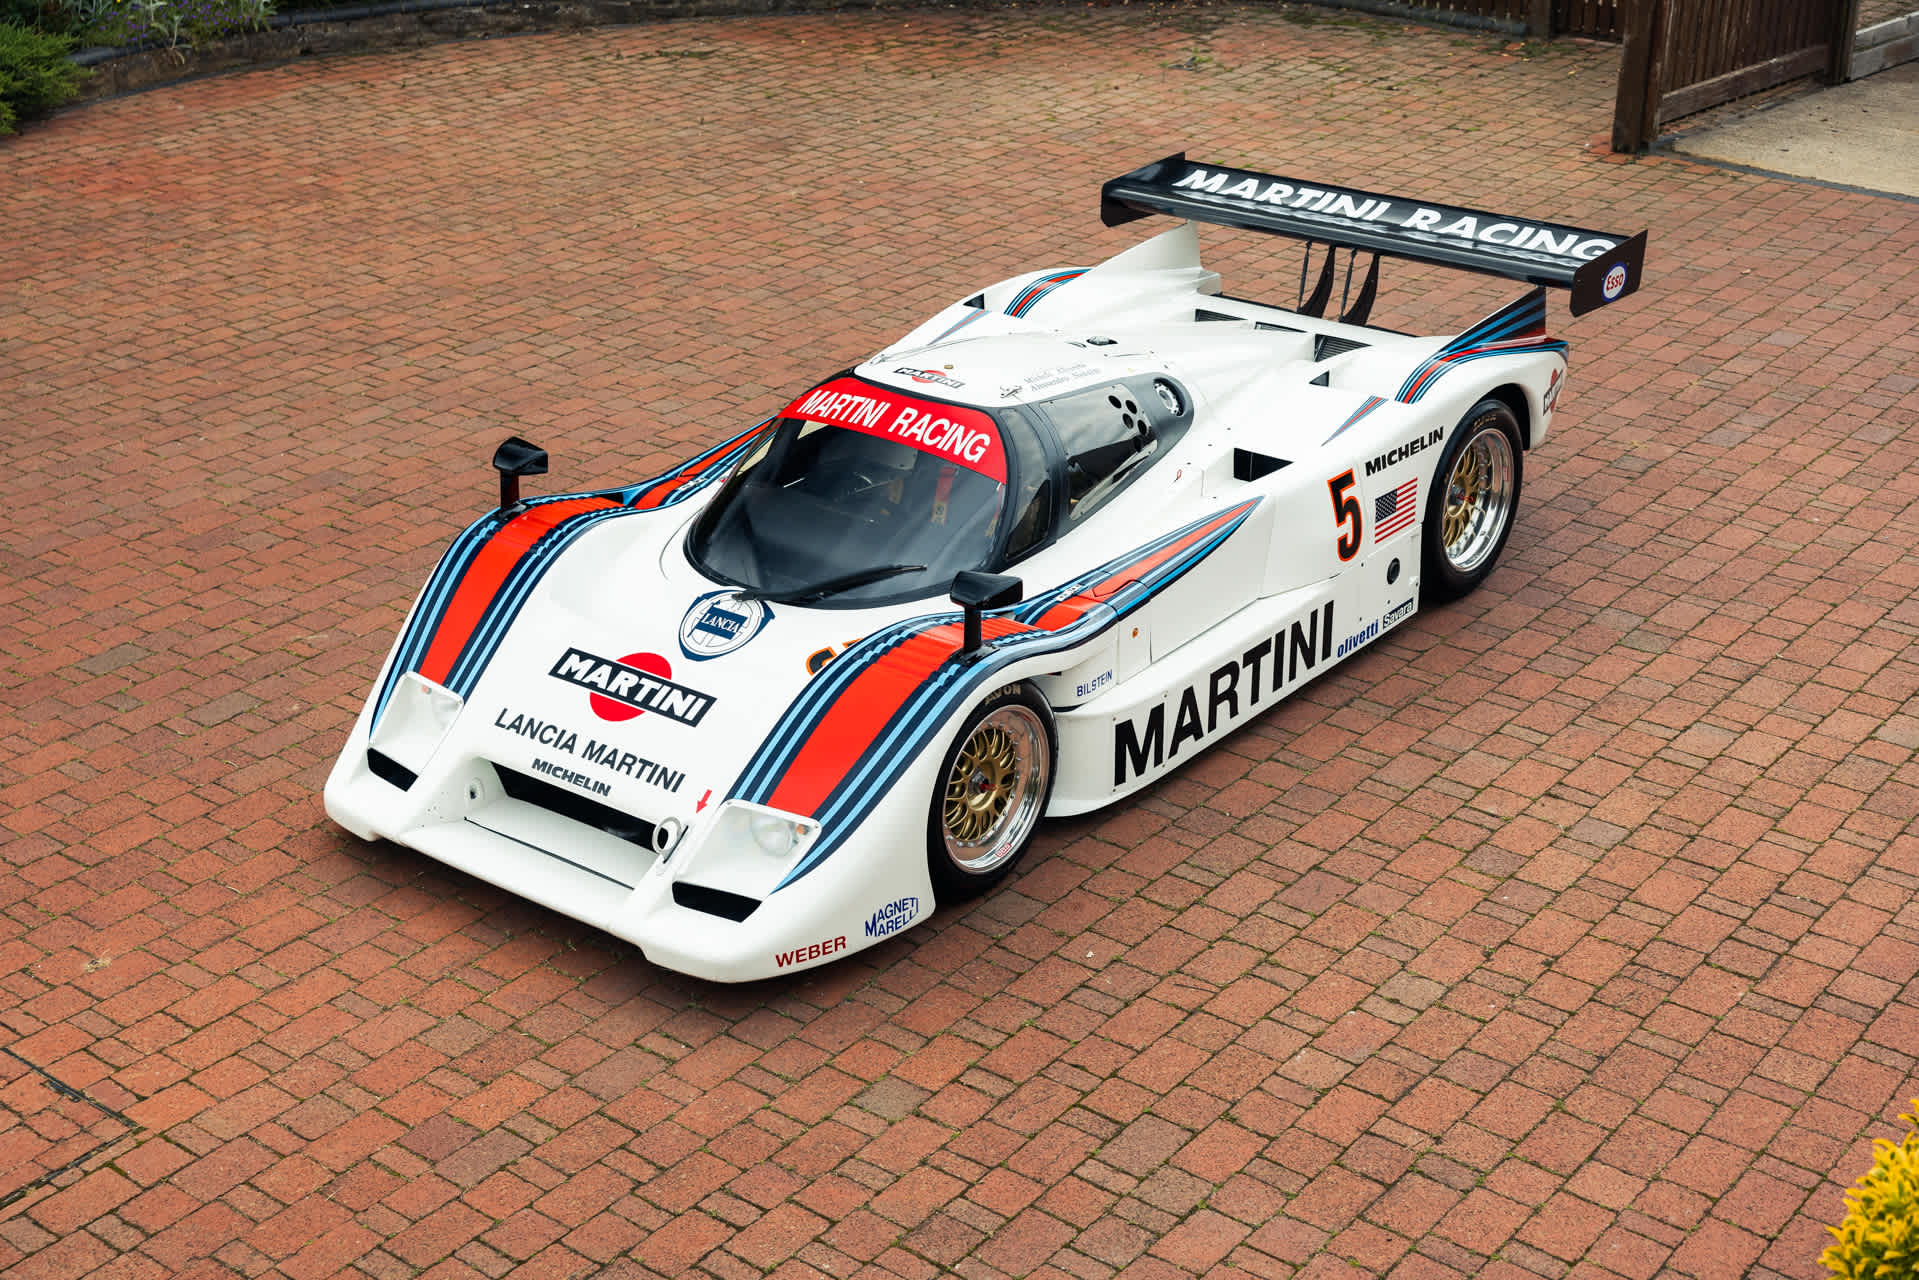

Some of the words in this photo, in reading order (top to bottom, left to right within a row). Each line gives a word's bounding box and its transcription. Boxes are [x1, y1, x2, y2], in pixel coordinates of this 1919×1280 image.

[1176, 168, 1391, 222] MARTINI
[1400, 207, 1616, 260] RACING
[897, 368, 962, 388] MARTINI
[796, 389, 891, 428] MARTINI
[888, 407, 991, 464] RACING
[1365, 426, 1444, 477] MICHELIN
[1327, 468, 1362, 562] 5
[701, 613, 740, 633] LANCIA
[1337, 619, 1379, 658] olivetti
[556, 653, 707, 721] MARTINI
[1076, 669, 1113, 698] BILSTEIN
[1114, 600, 1334, 787] MARTINI
[494, 708, 578, 755] LANCIA
[581, 739, 686, 793] MARTINI
[531, 758, 611, 797] MICHELIN
[775, 936, 847, 968] WEBER
